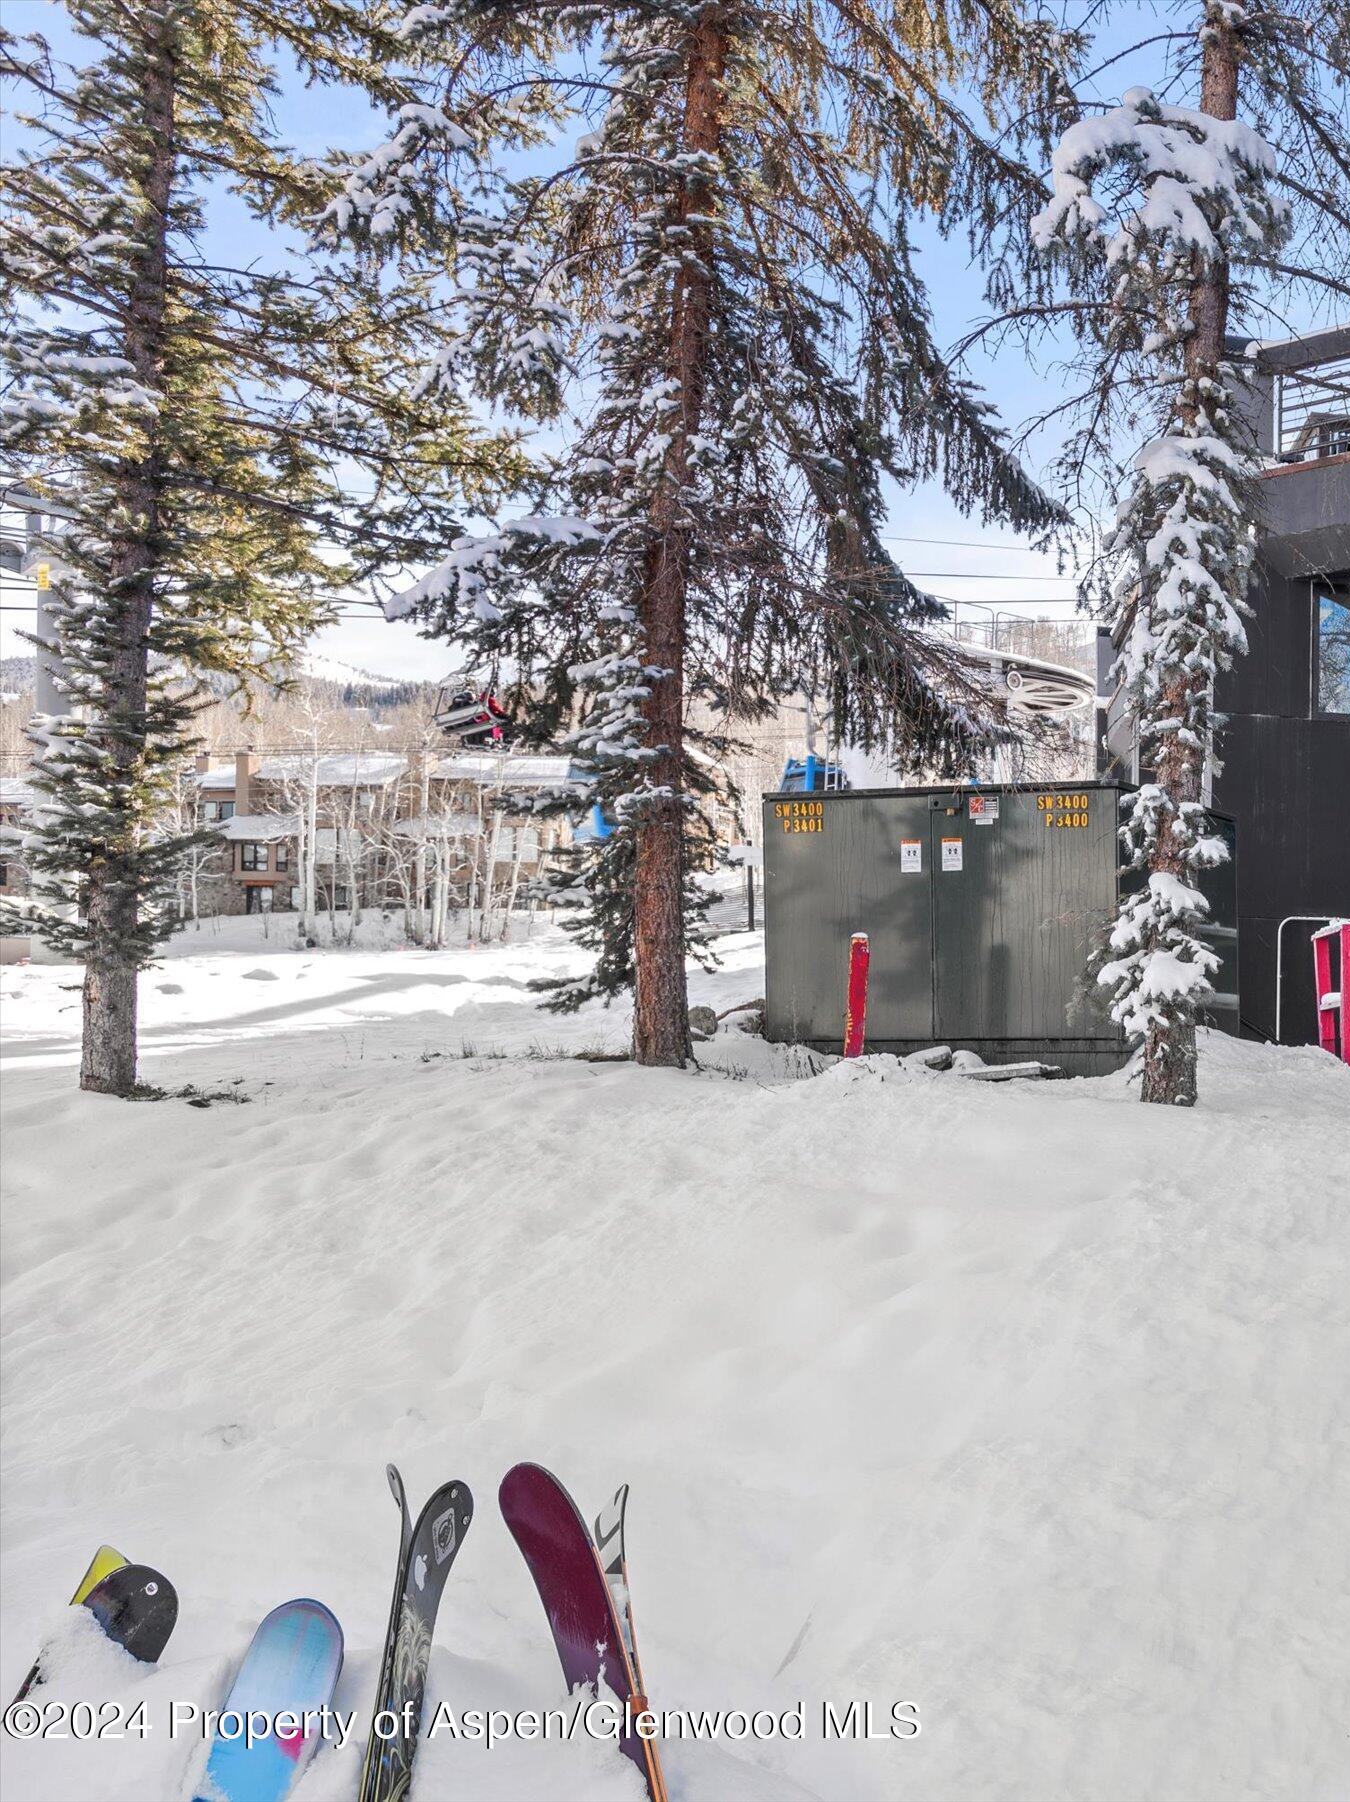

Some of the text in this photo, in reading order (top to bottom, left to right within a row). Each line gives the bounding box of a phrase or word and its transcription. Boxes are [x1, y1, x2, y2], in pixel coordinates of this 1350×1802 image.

[1037, 795, 1088, 810] SW 3400
[775, 802, 823, 818] SW 3400
[783, 819, 823, 832] P 3401
[1046, 813, 1053, 827] P
